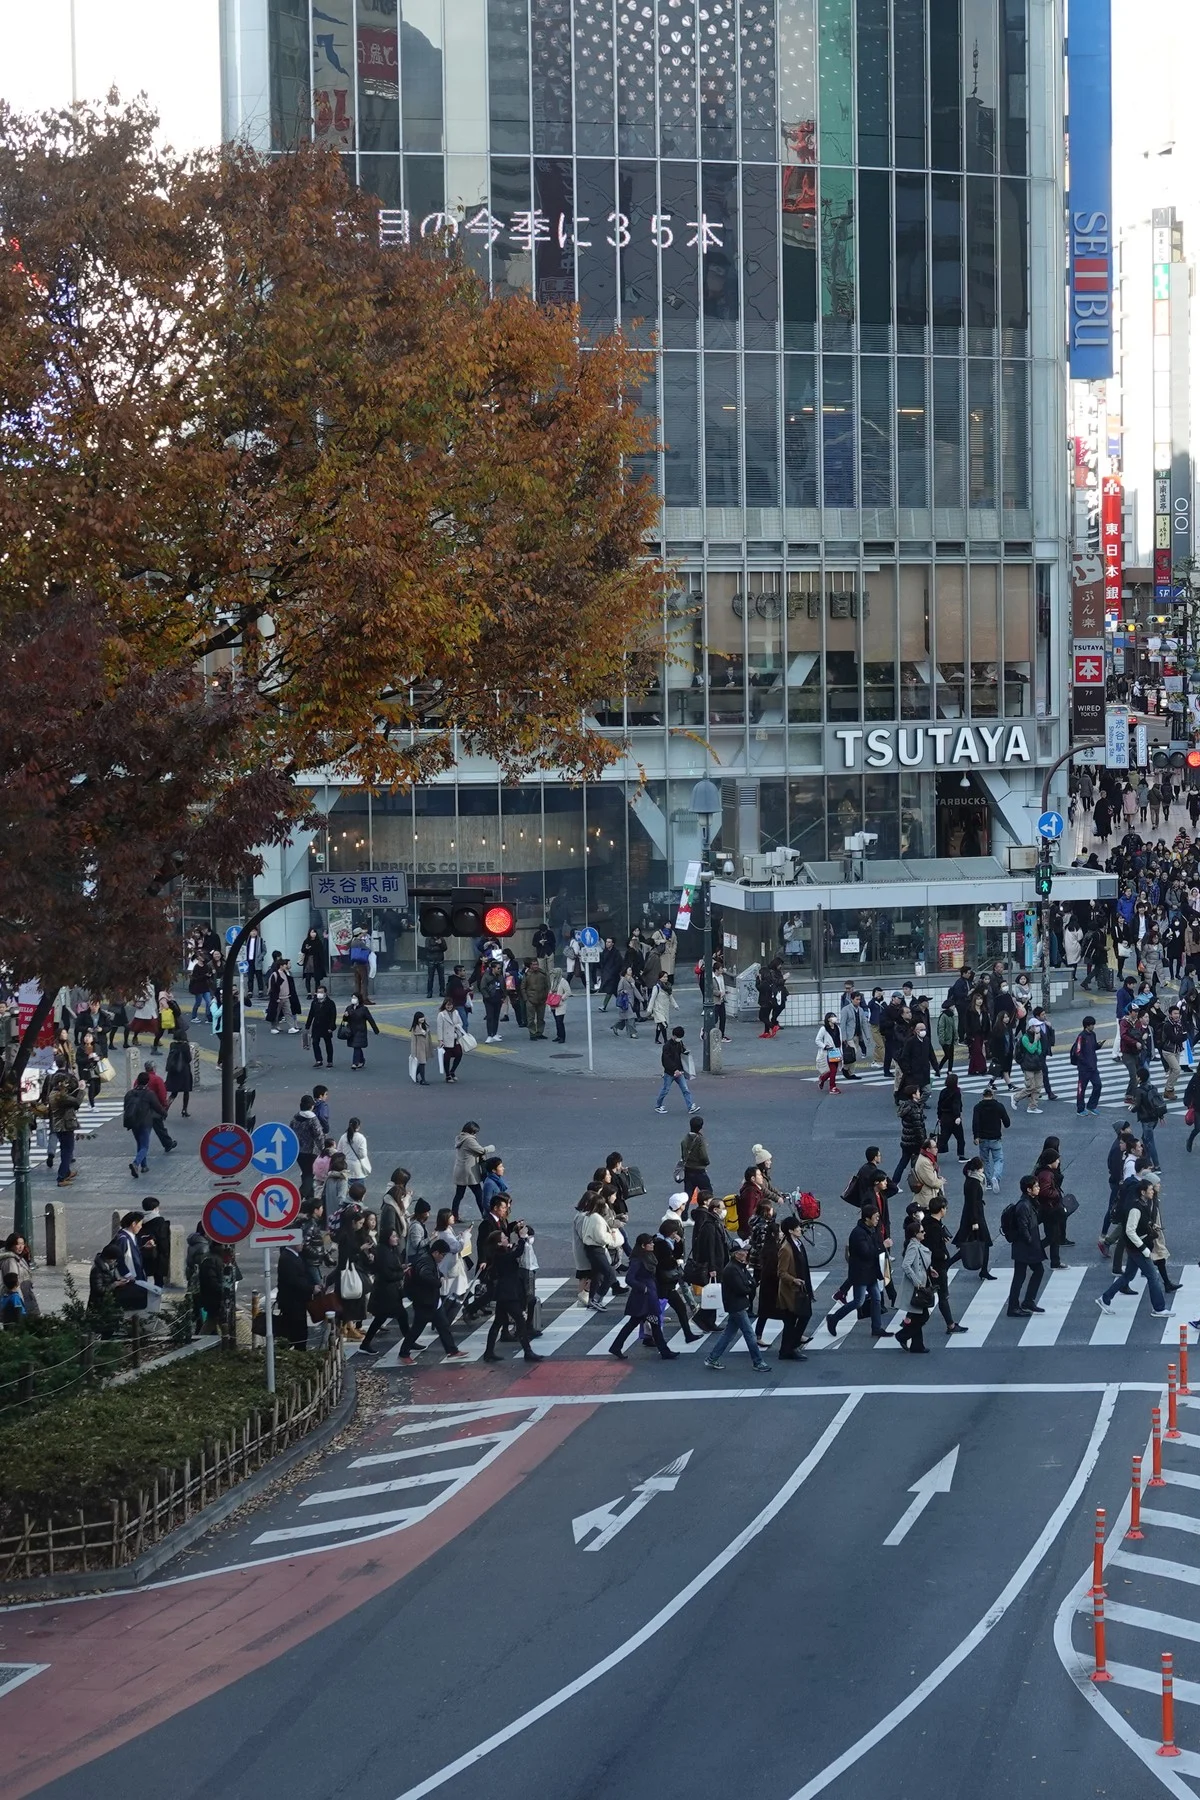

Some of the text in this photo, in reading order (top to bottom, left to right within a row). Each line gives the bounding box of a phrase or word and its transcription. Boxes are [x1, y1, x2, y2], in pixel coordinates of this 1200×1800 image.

[1074, 211, 1109, 349] SEIBU
[1078, 658, 1099, 680] 本
[836, 725, 1030, 768] TSUTAYA
[1115, 719, 1126, 764] 渋谷駅前
[936, 796, 986, 806] TARBUCKS
[358, 860, 495, 873] STARBUCKS COFFEE
[318, 876, 399, 894] 渋谷駅前
[332, 894, 392, 906] Shibuya Sta.
